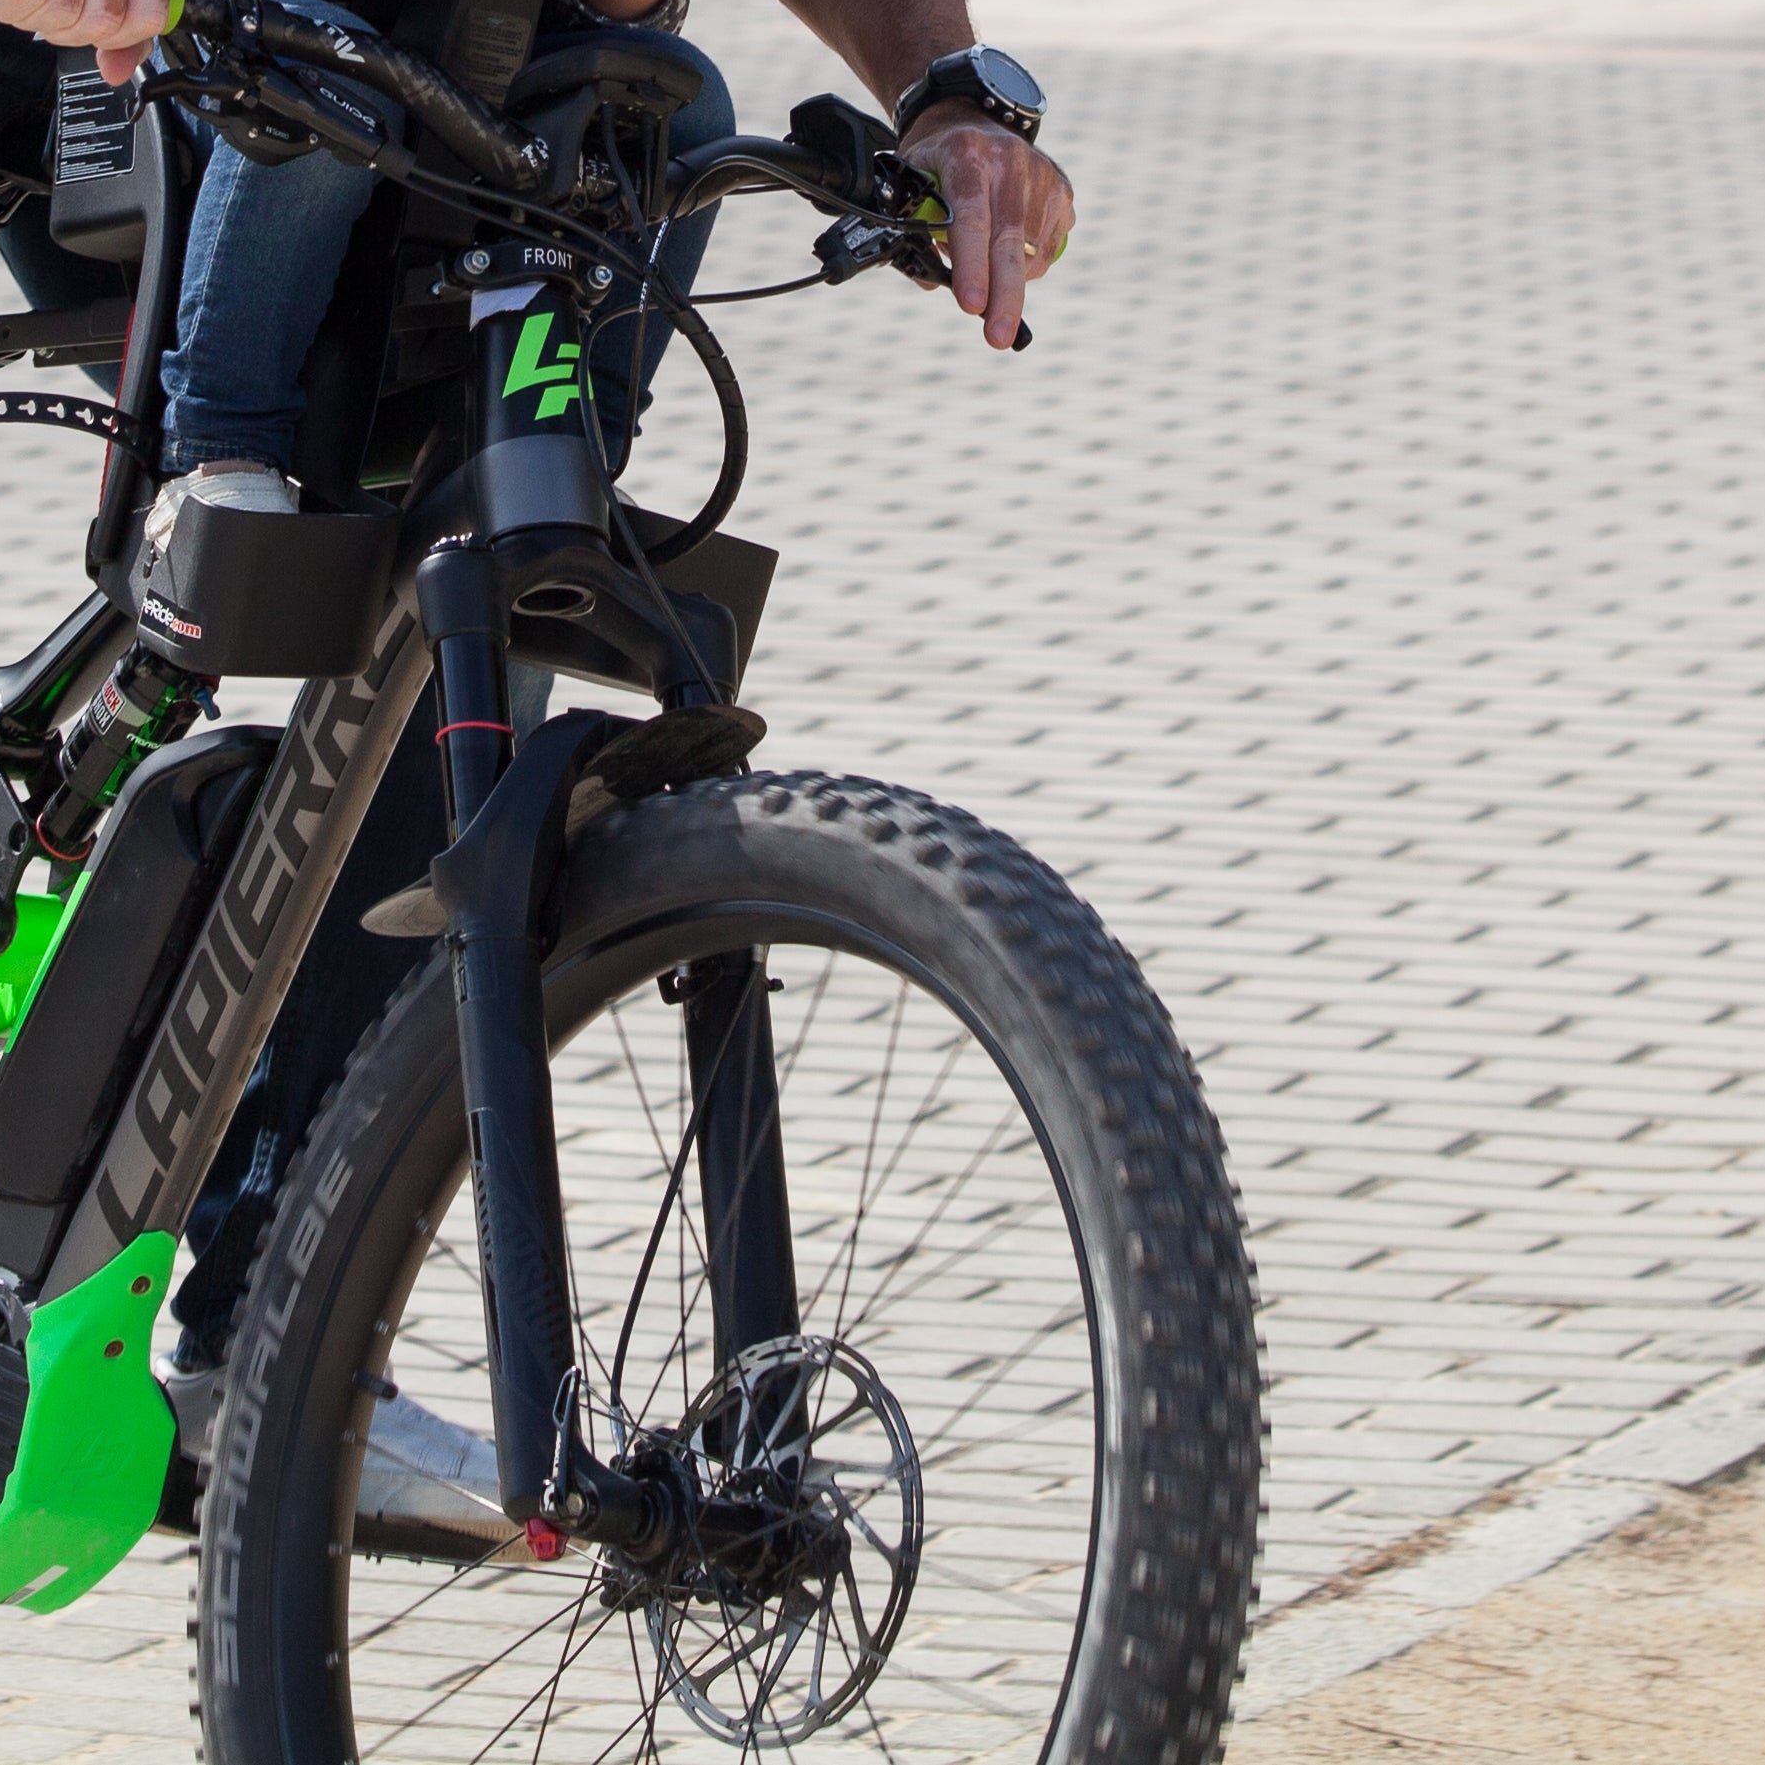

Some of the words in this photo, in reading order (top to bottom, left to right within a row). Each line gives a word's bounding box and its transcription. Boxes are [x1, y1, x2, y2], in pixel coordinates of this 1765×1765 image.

[319, 86, 376, 128] GUIDE
[524, 247, 573, 271] FRONT
[213, 1146, 355, 1686] SCHWALBE
